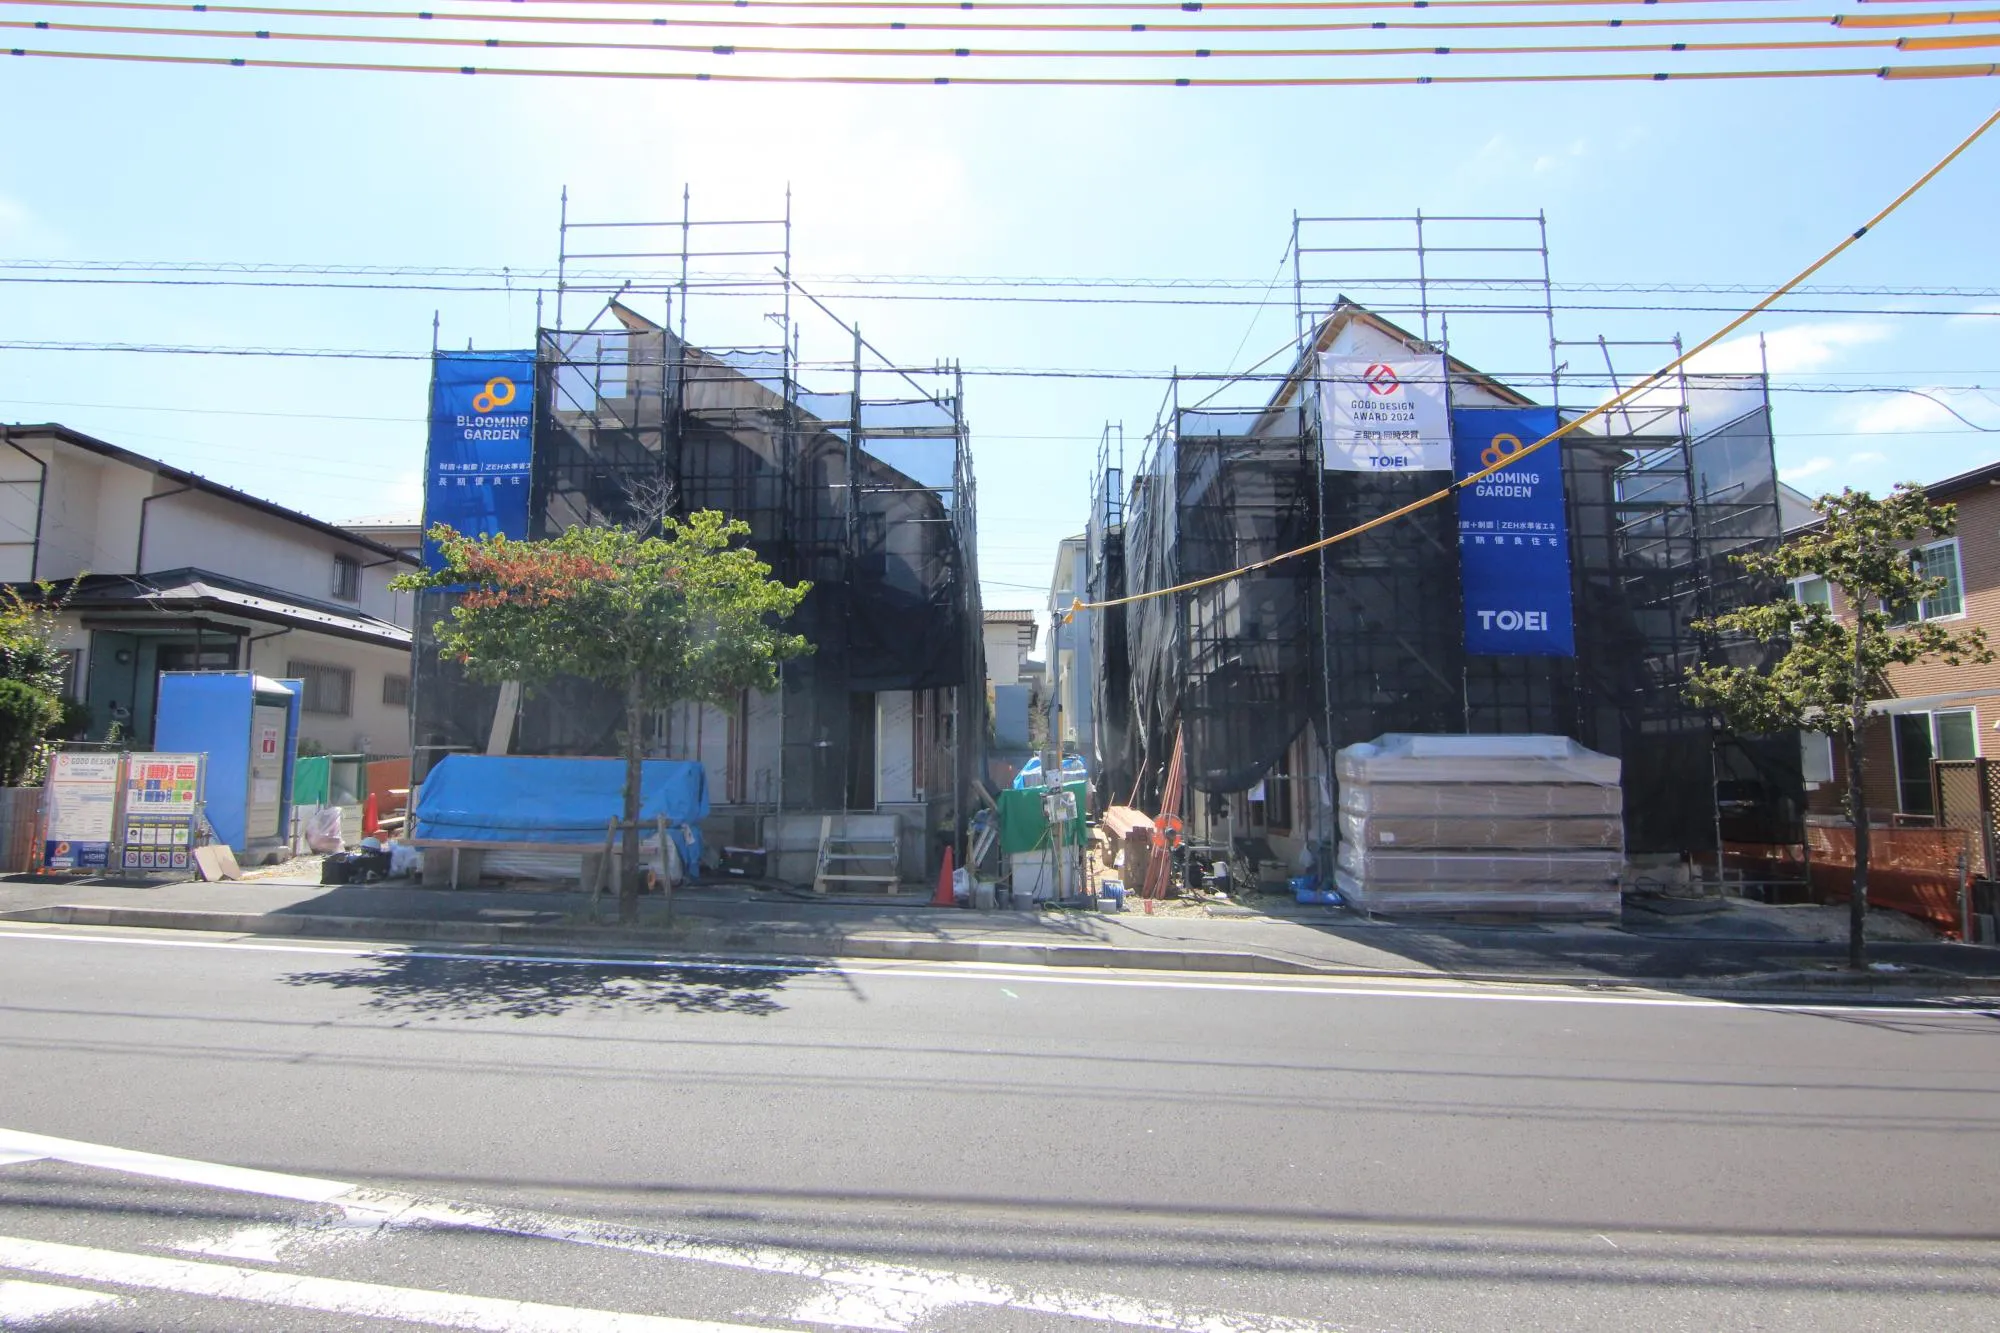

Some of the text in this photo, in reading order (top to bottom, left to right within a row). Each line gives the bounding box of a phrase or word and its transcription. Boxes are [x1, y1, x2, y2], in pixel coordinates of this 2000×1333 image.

[1351, 400, 1414, 410] GOOD DESIGN
[457, 415, 528, 428] BLOOMING
[1353, 412, 1414, 421] AWARD 2024
[464, 429, 520, 440] GARDEN
[1369, 456, 1408, 466] TOEI
[1476, 486, 1532, 498] GARDEN
[1477, 610, 1548, 631] TOEI
[71, 757, 117, 765] GOOD DESIGN
